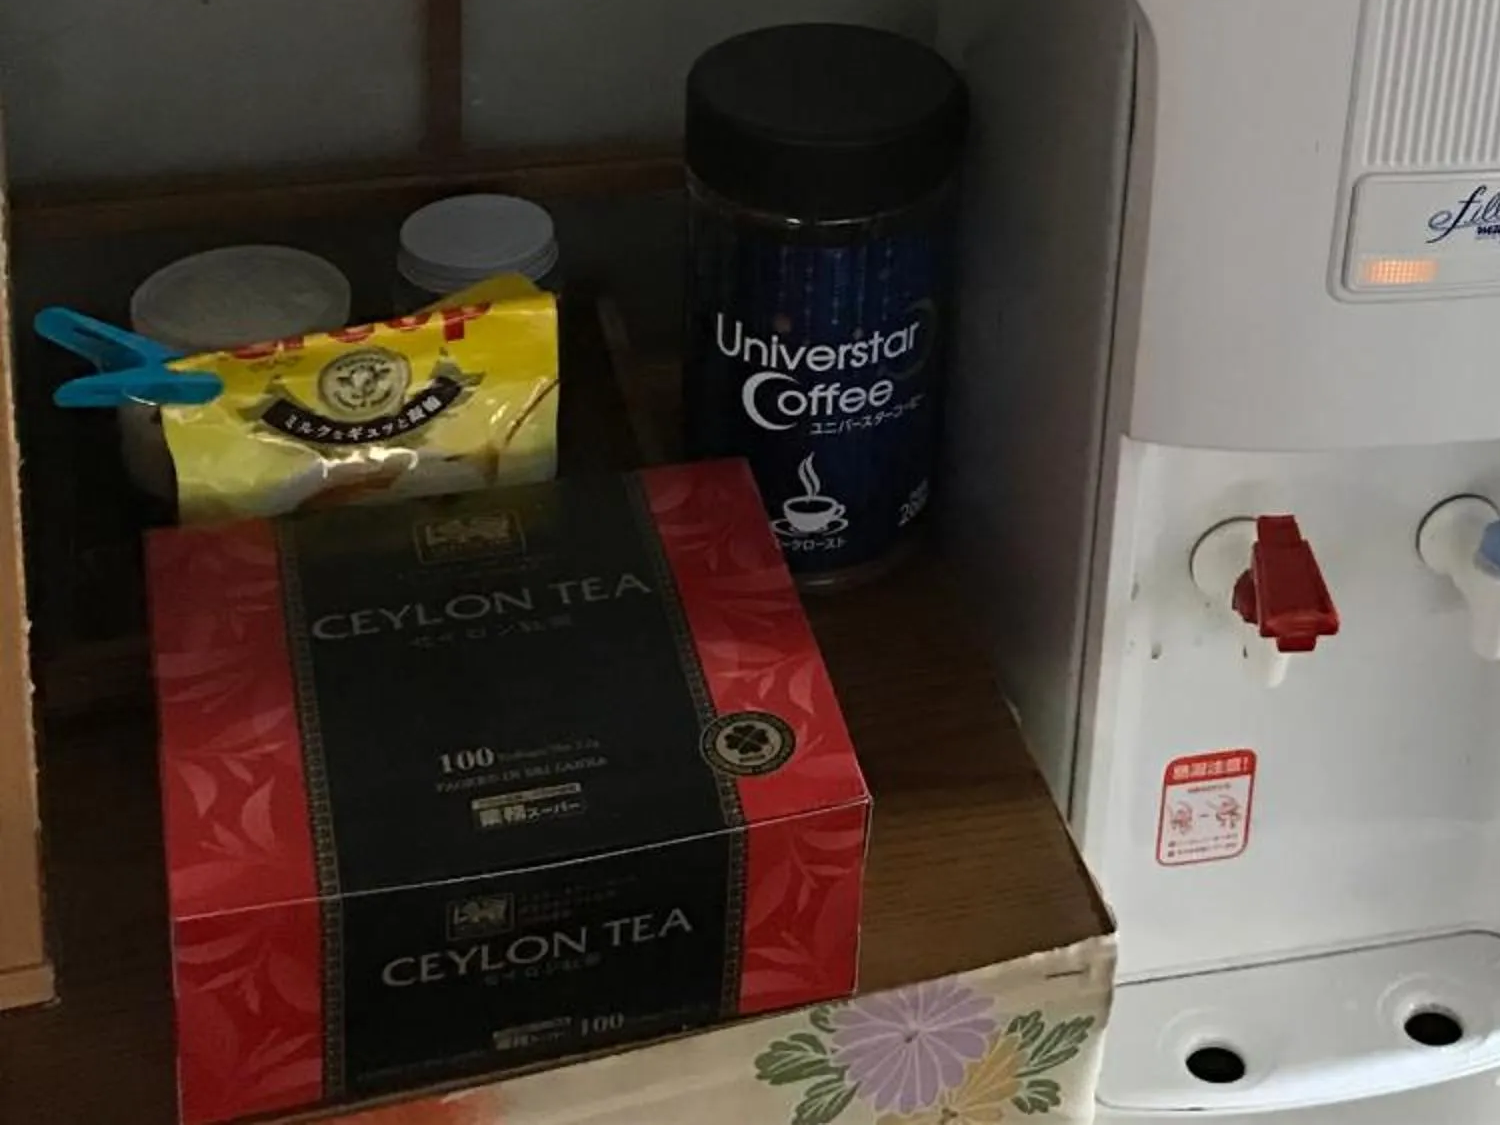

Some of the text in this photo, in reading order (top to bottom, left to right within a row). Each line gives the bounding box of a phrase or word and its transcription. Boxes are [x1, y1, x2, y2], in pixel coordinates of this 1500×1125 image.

[717, 312, 920, 372] Universtar
[742, 371, 894, 431] Coffee
[311, 571, 654, 640] CEYLON TEA
[438, 746, 497, 774] 100
[381, 907, 694, 987] CEYLON TEA
